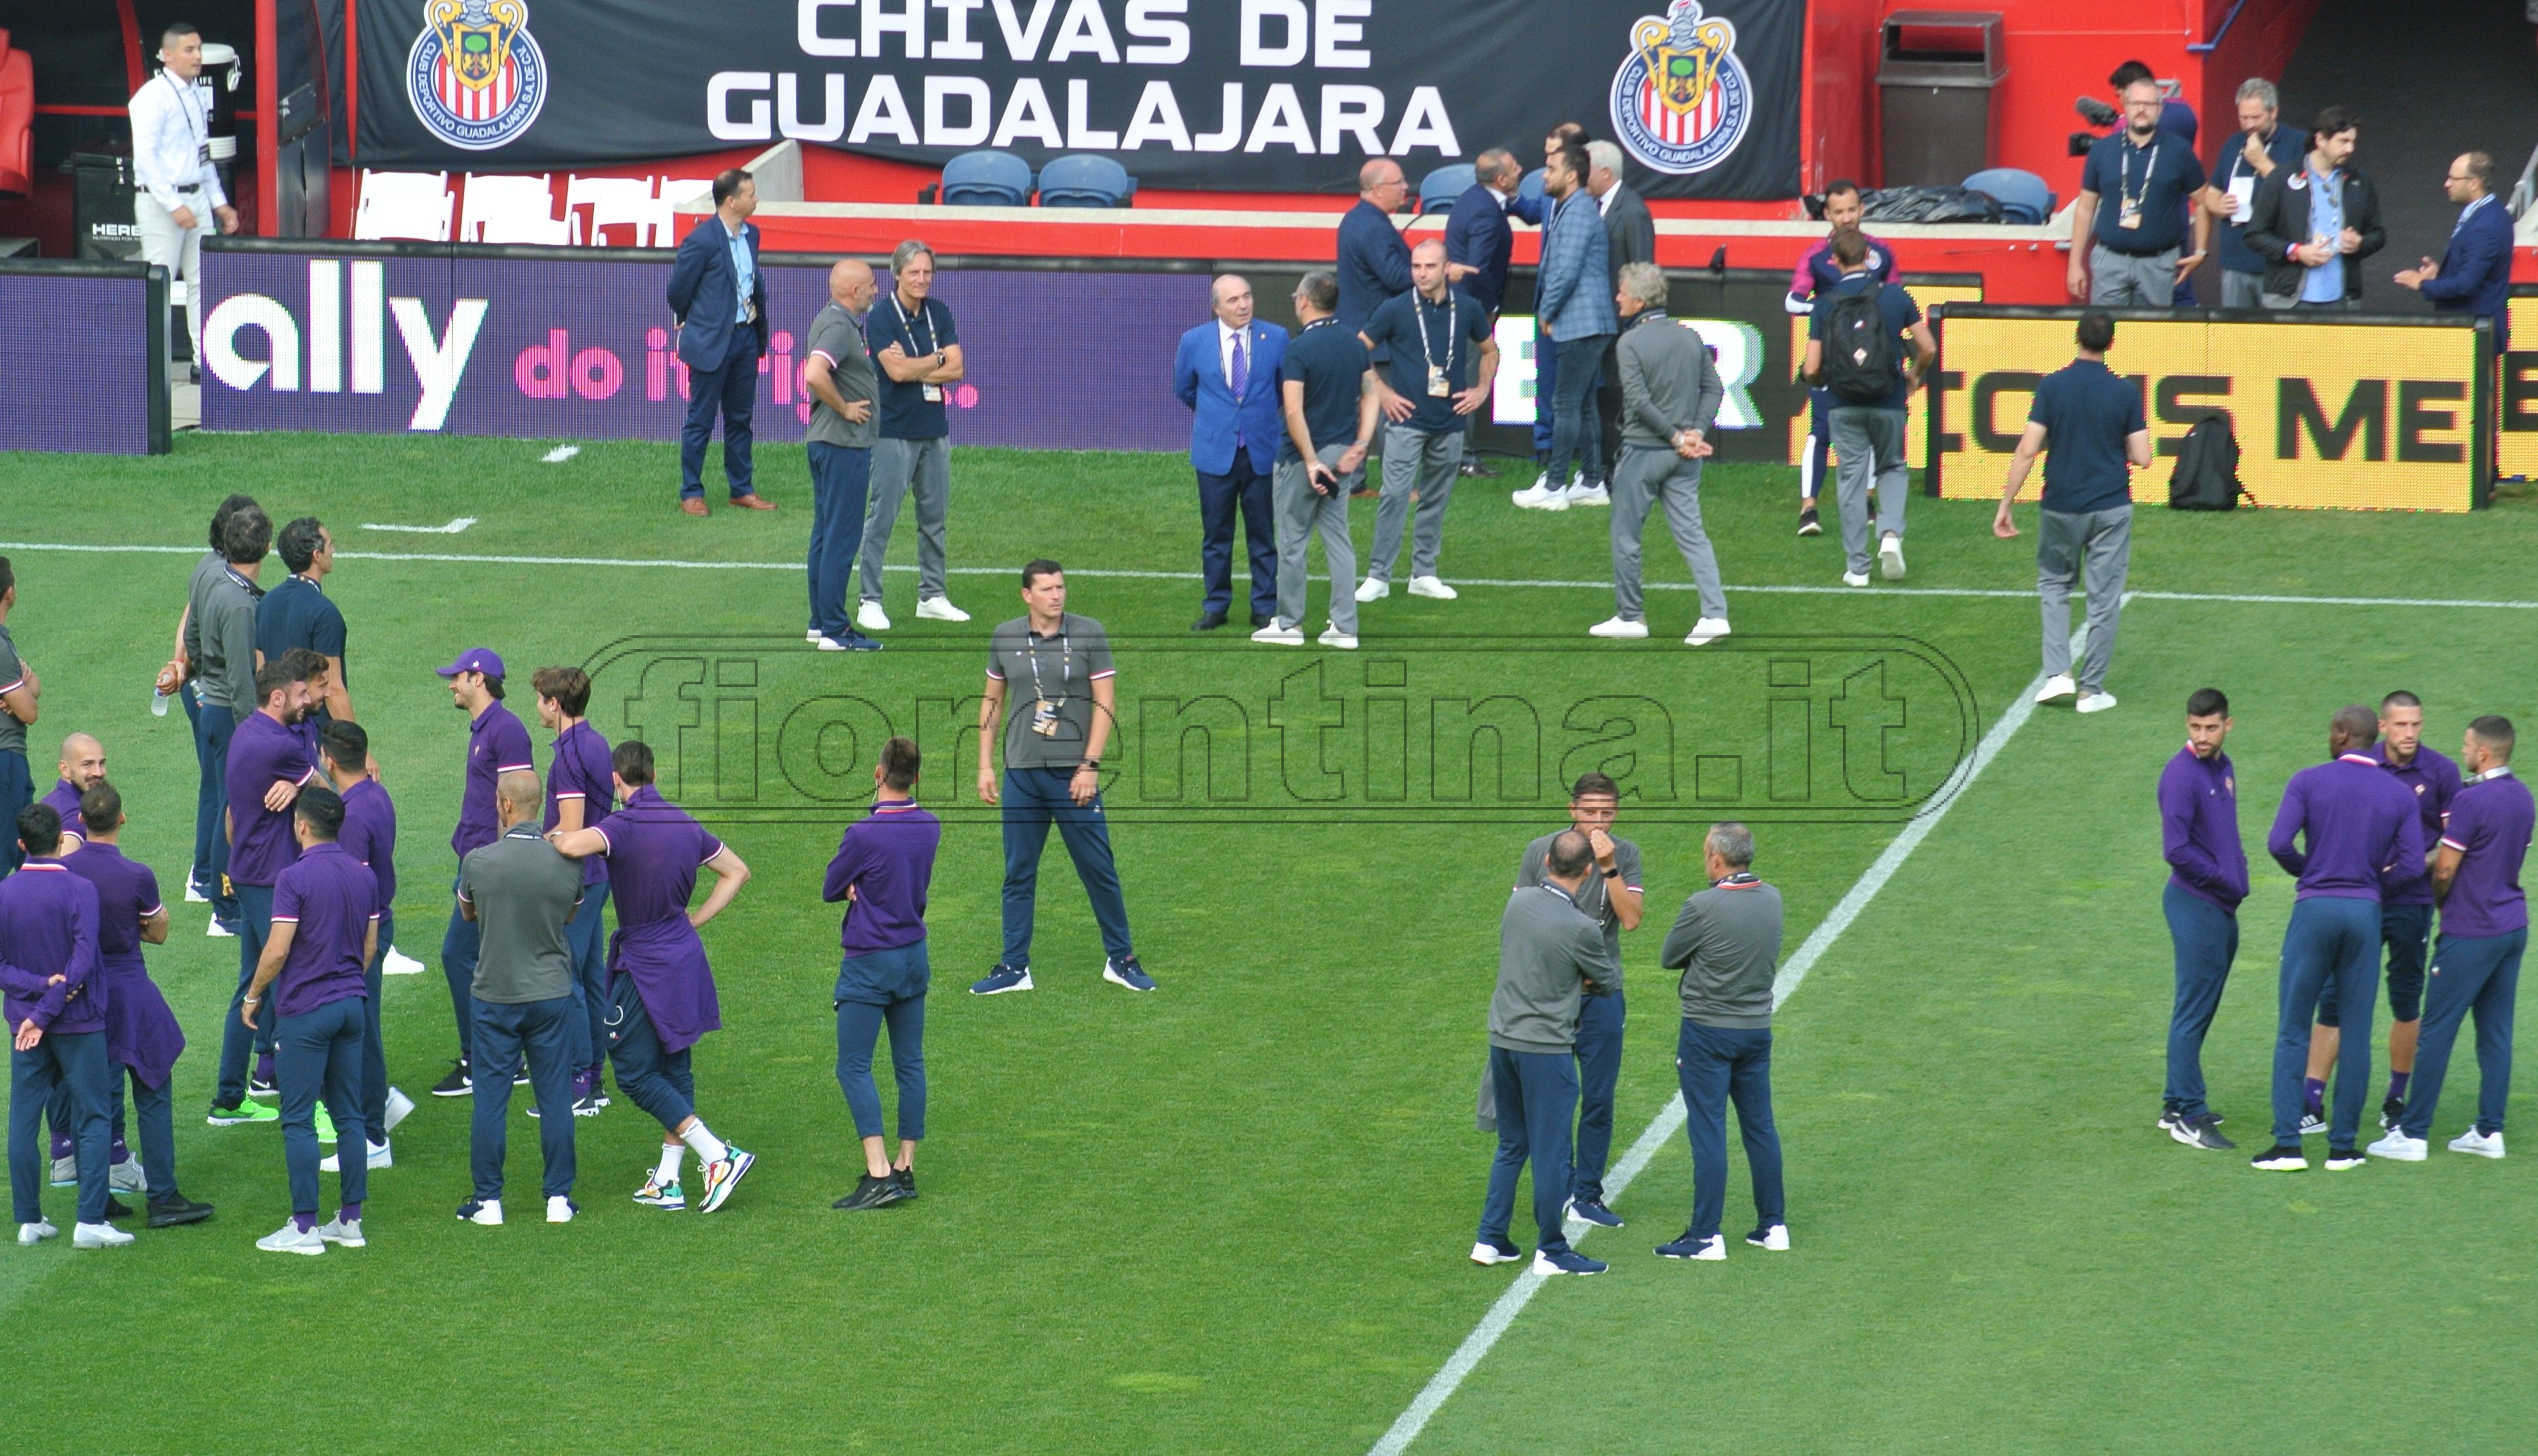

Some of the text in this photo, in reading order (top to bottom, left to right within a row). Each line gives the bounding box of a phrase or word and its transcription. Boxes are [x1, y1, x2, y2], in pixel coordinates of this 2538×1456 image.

[418, 42, 437, 72] CLUB
[798, 0, 1372, 68] CHIVAS DE
[418, 73, 455, 131] DEPORTIVO
[456, 103, 528, 139] GUADALAJARA
[707, 72, 1461, 157] GUADALAJARA
[201, 259, 489, 431] ally
[514, 327, 624, 401] do
